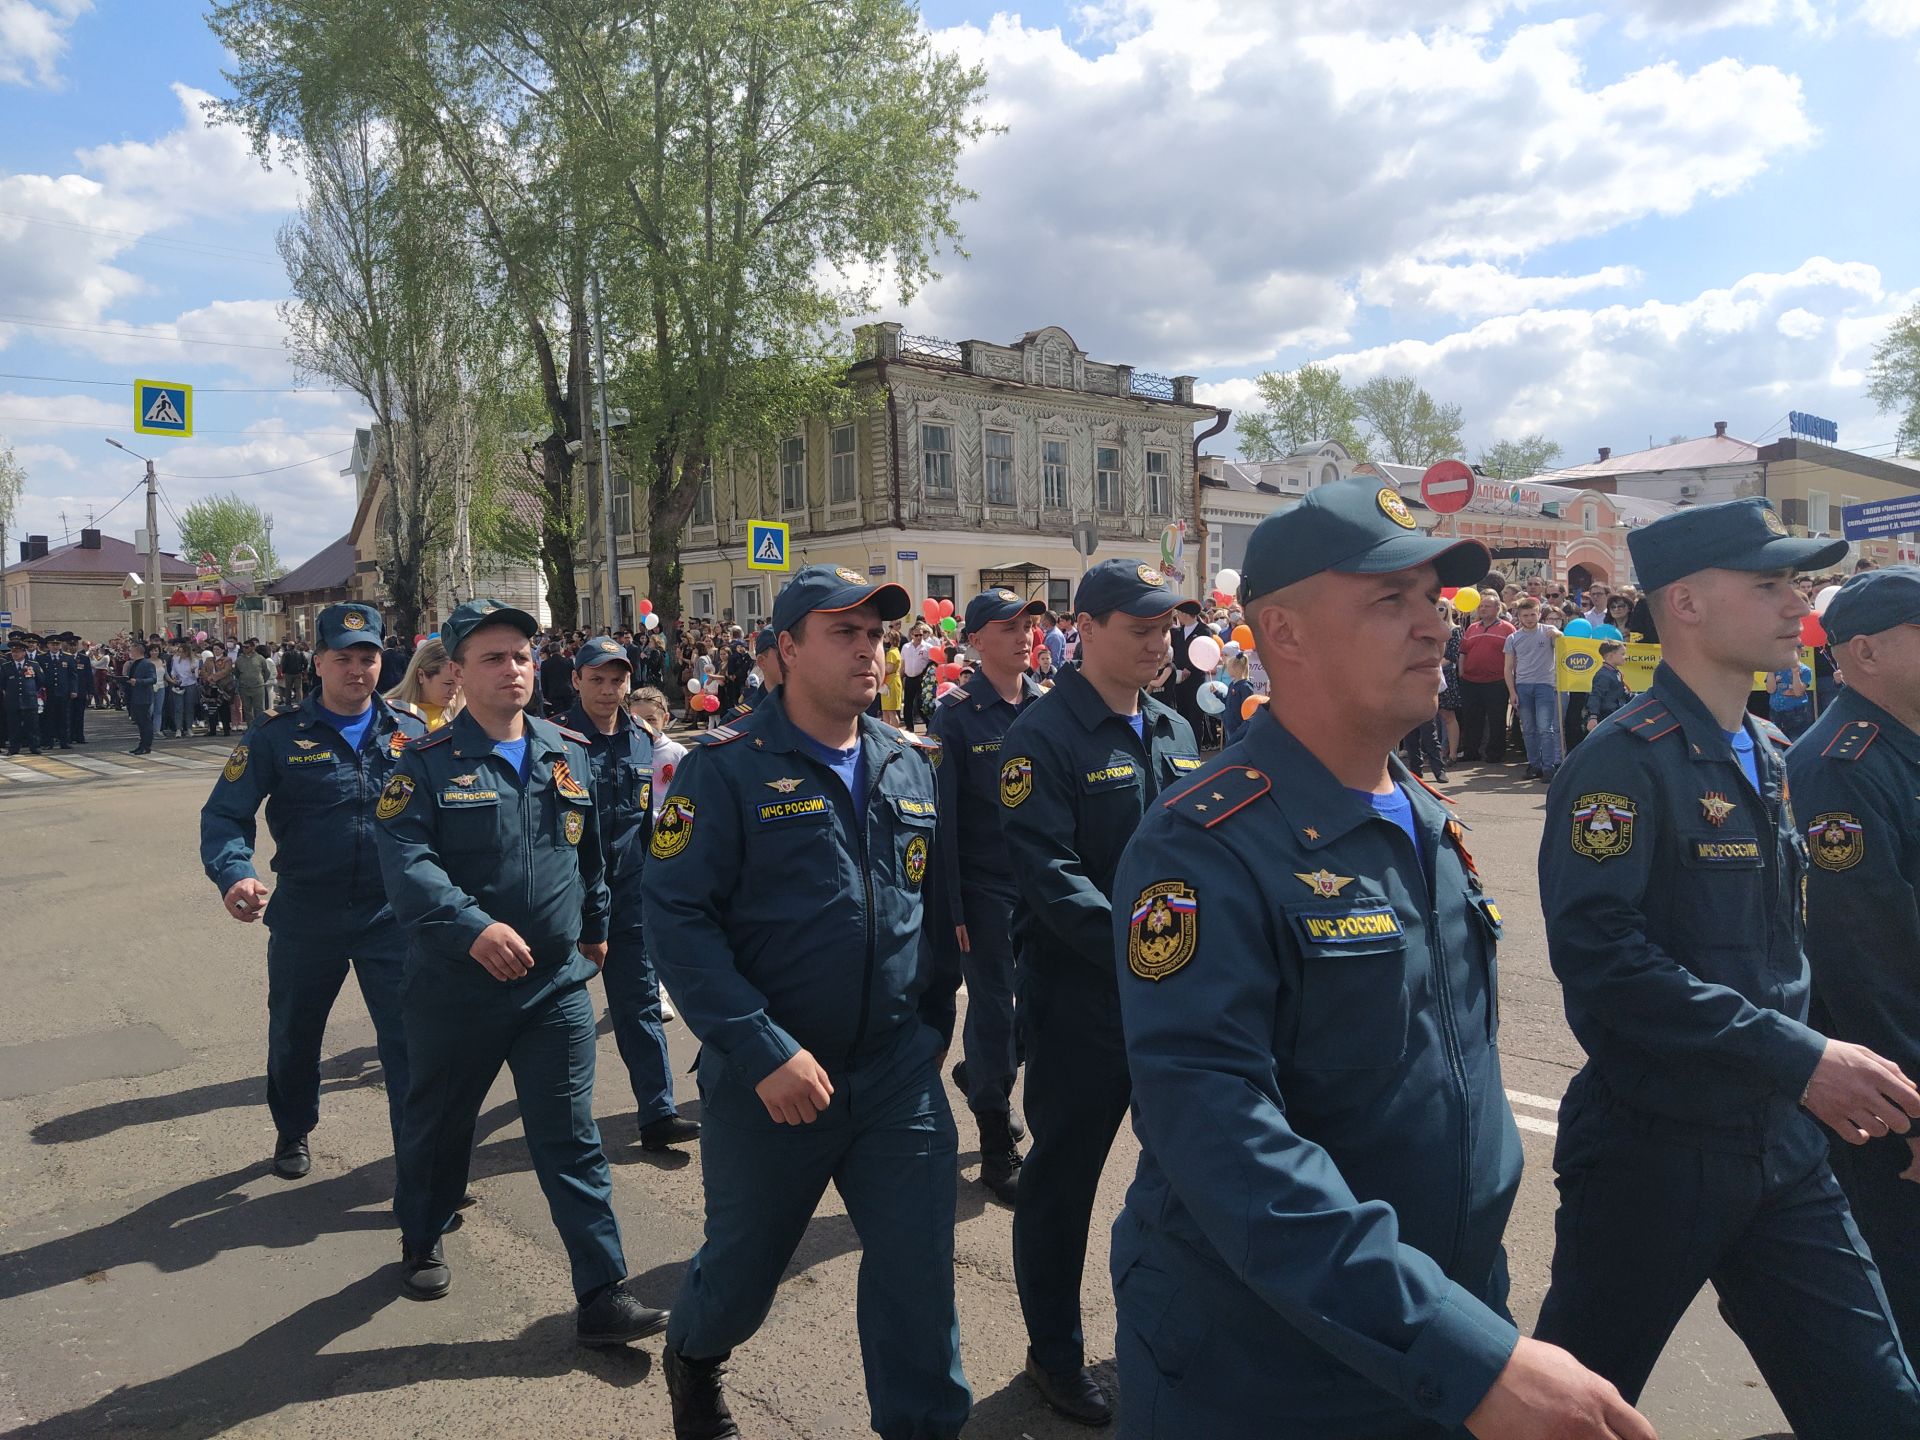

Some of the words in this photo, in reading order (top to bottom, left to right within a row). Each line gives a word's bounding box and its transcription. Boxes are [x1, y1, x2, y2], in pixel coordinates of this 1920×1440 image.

[1789, 410, 1838, 443] SAMSUNG
[1477, 484, 1509, 500] АПТЕКА
[1519, 489, 1541, 503] ВИТА
[1570, 657, 1590, 665] КИУ
[304, 751, 331, 763] РОССИИ
[1087, 770, 1106, 783] МЧС
[1106, 765, 1134, 779] РОССИИ
[446, 792, 464, 800] МЧС
[464, 791, 497, 801] РОССИИ
[1582, 796, 1597, 806] МЧС
[1598, 794, 1626, 806] РОССИИ
[761, 805, 784, 819] МЧС
[784, 798, 825, 815] РОССИИ
[1698, 843, 1718, 857] МЧС
[1718, 843, 1759, 858] РОССИИ
[1325, 882, 1331, 891] 2
[1307, 918, 1337, 937] МЧС
[1336, 914, 1398, 937] РОССИИ
